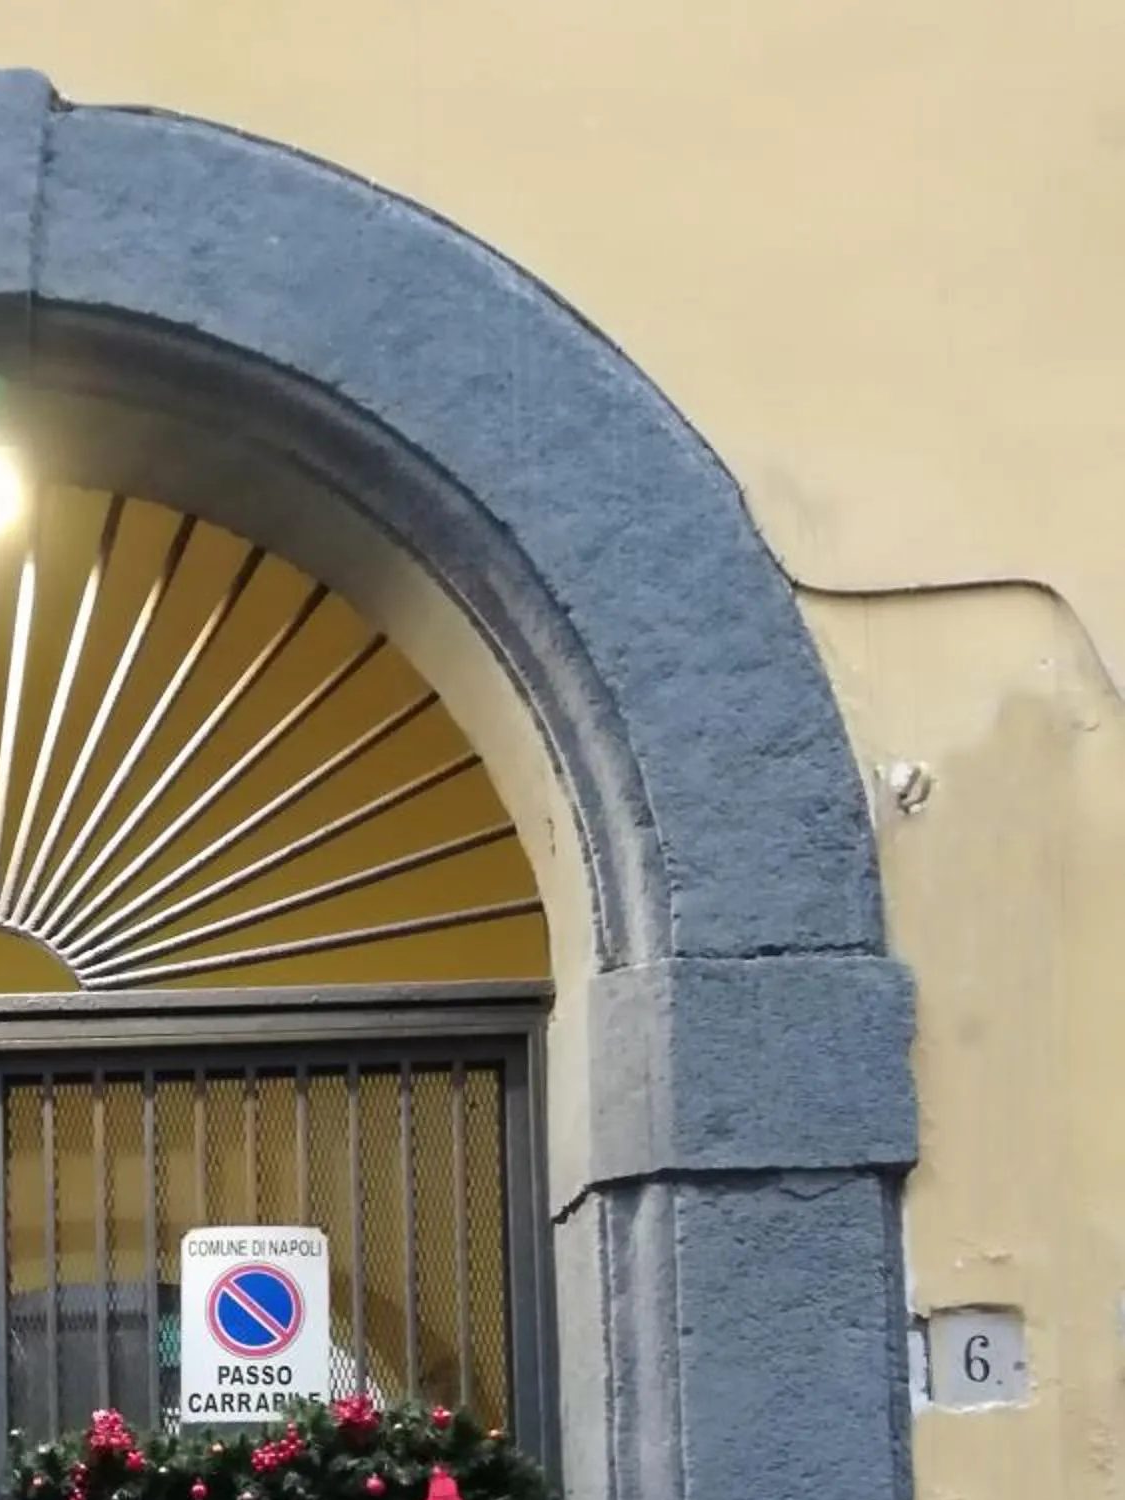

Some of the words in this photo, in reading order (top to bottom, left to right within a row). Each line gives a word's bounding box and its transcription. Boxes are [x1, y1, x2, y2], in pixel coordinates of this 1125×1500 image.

[188, 1239, 248, 1257] COMUNE
[252, 1239, 266, 1257] DI
[269, 1239, 322, 1257] NAPOLI
[964, 1334, 990, 1383] 6
[218, 1365, 293, 1386] PASSO
